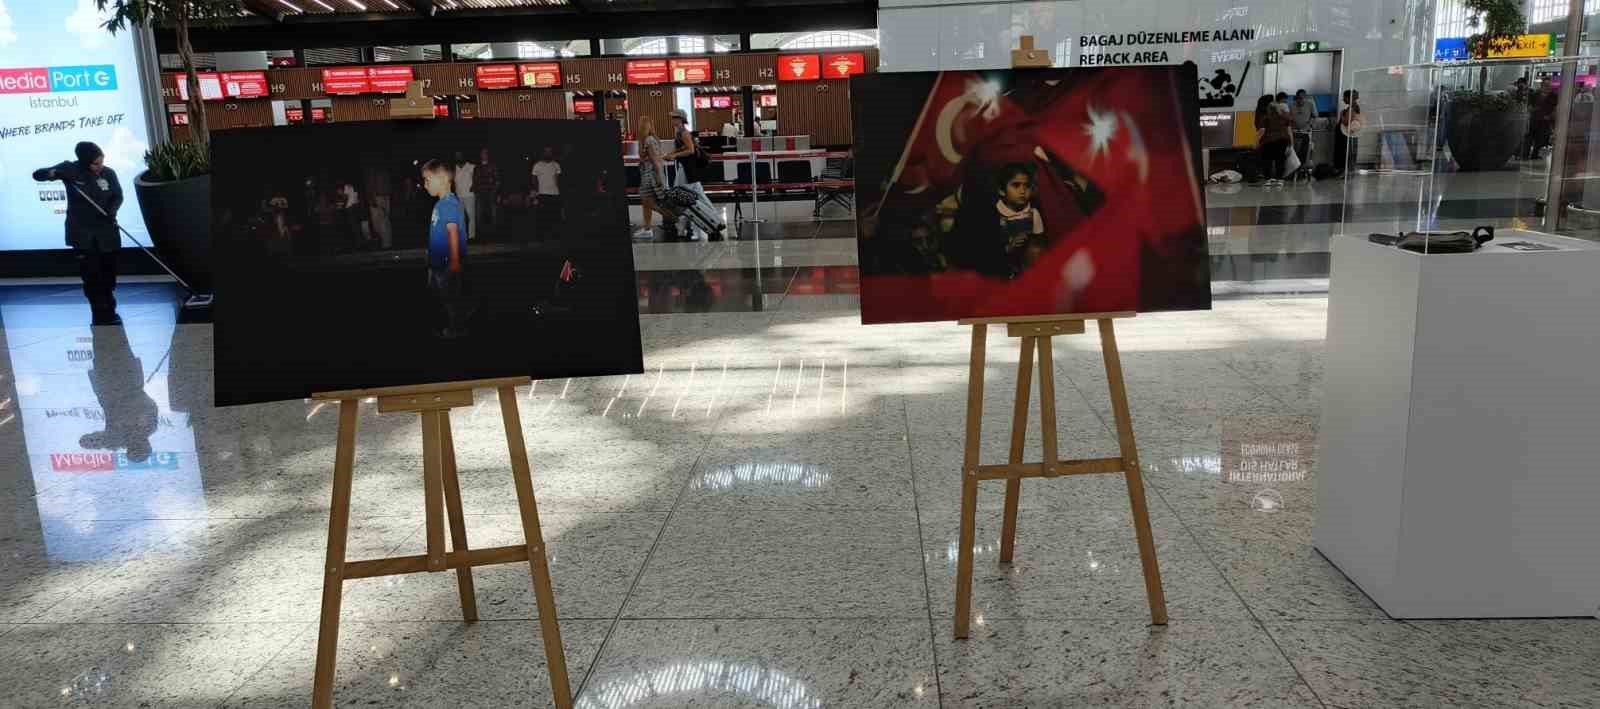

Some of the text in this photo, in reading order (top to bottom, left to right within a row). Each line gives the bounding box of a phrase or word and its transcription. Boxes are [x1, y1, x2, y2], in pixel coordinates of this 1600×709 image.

[1079, 29, 1256, 48] BAGAJ DÜZENLEME ALANI
[1079, 50, 1169, 66] REPACK AREA
[607, 73, 624, 83] H4
[716, 69, 731, 80] H3
[759, 68, 774, 78] H2
[0, 71, 48, 90] edia
[52, 71, 92, 88] Port
[458, 77, 474, 88] H6
[566, 74, 582, 84] H5
[271, 83, 286, 94] H9
[34, 119, 76, 135] BRANDS
[79, 116, 104, 129] TAKE
[107, 113, 125, 126] OFF
